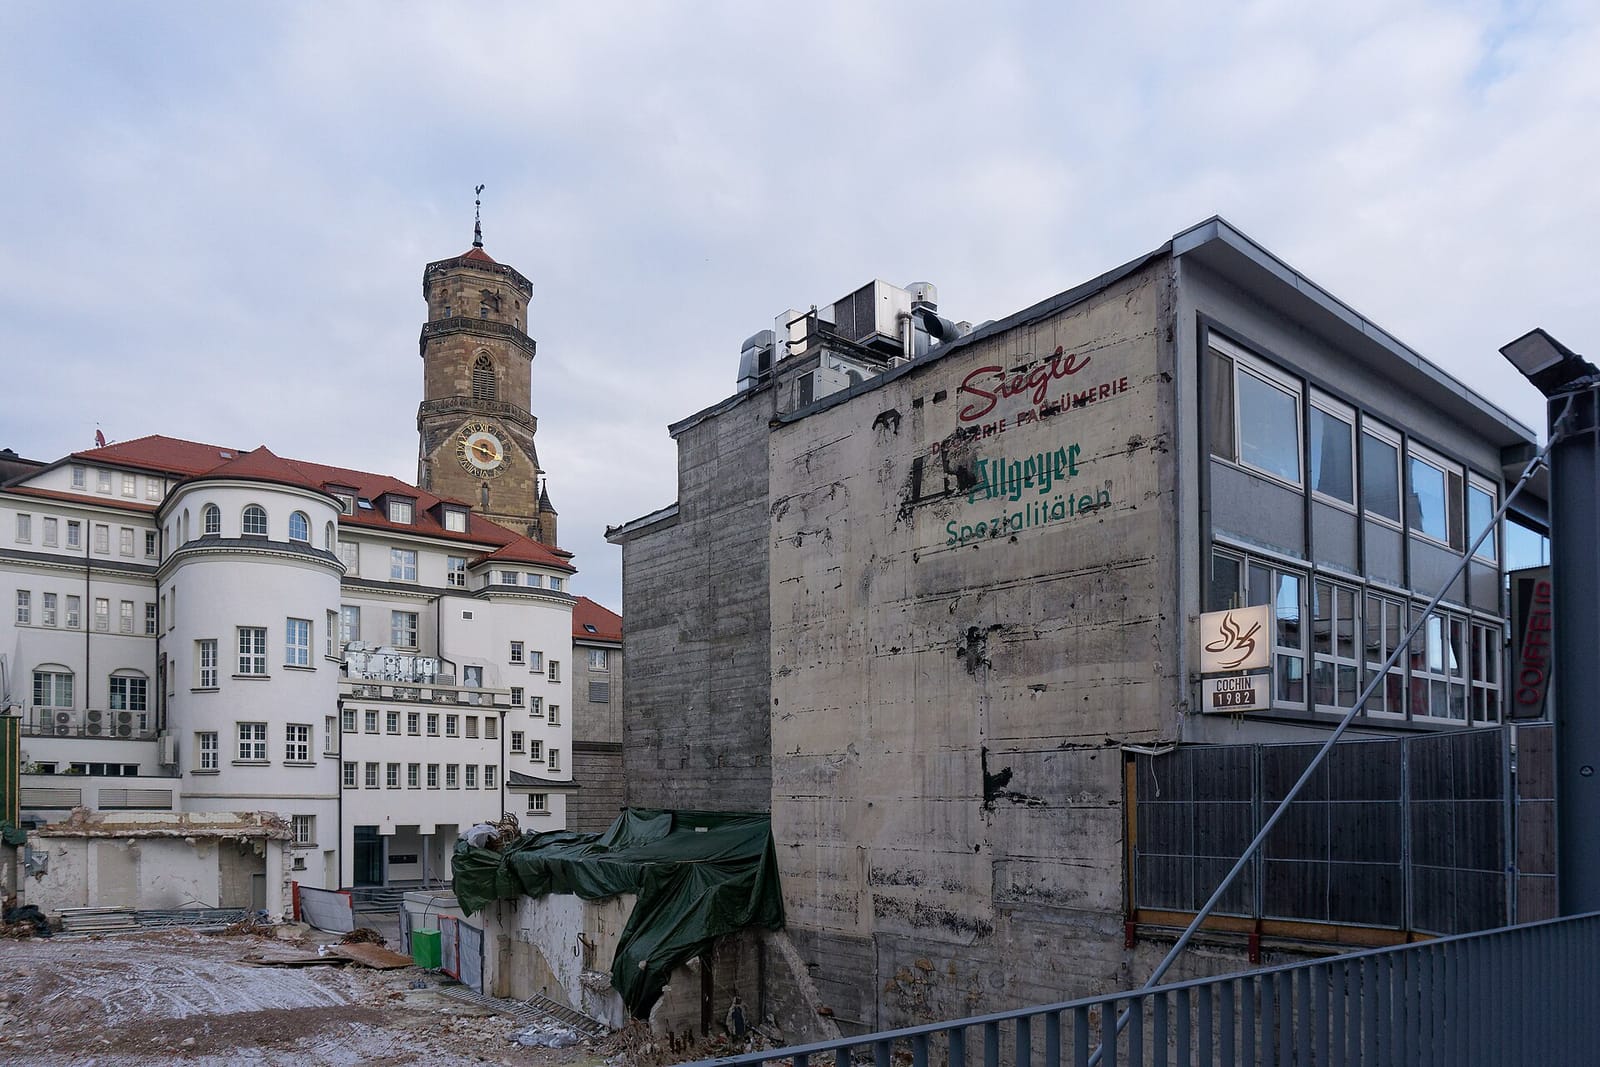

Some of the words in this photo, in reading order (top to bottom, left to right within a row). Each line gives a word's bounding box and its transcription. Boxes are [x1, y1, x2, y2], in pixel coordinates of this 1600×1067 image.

[959, 346, 1090, 421] Siegle
[967, 442, 1081, 504] Allgeyer
[946, 488, 1112, 546] Spezialitäten
[1216, 677, 1251, 692] COCHIN
[1218, 691, 1250, 705] 1982
